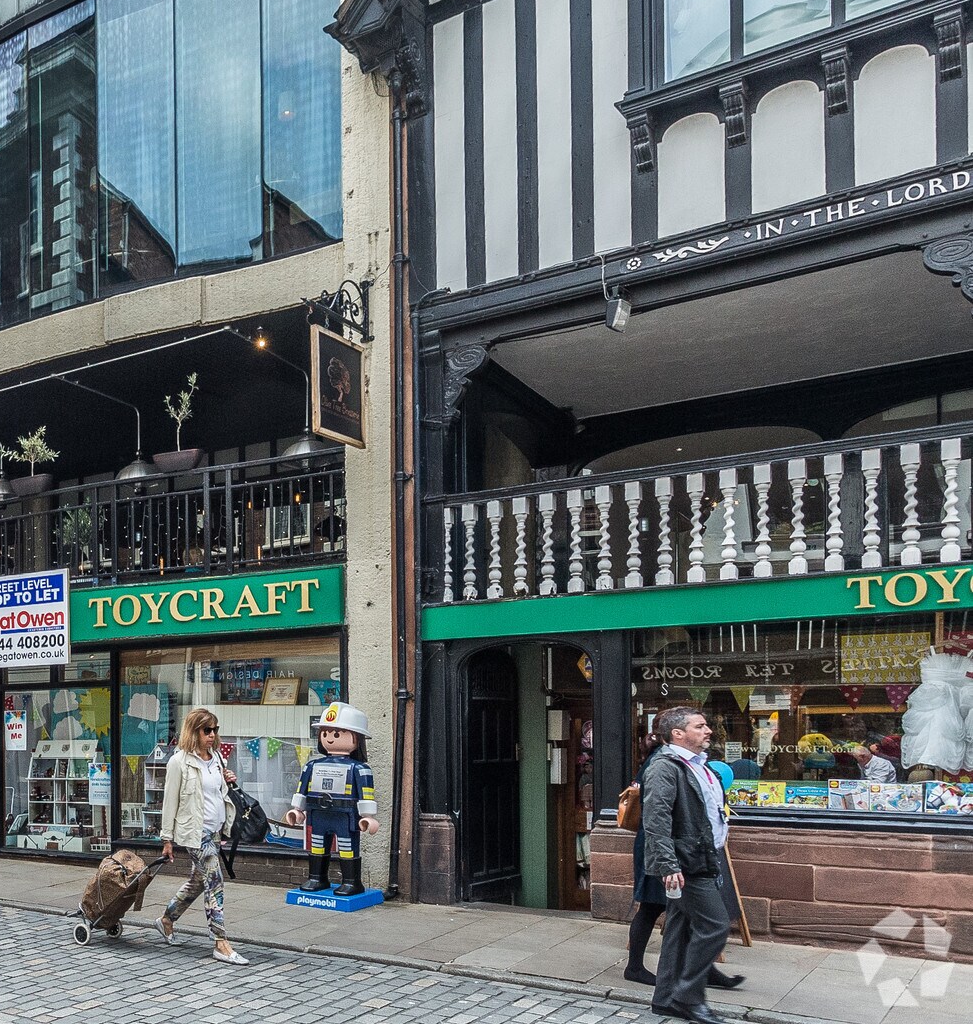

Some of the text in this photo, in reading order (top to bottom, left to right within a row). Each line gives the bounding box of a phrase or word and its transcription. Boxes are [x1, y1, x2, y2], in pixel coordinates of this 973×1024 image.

[755, 218, 785, 241] IN
[803, 197, 866, 228] THE
[21, 578, 52, 591] LEVEL
[847, 567, 973, 609] TOY
[13, 591, 32, 604] TO
[35, 588, 60, 602] LET
[88, 578, 320, 628] TOYCRAFT
[17, 633, 65, 650] 408200
[297, 895, 337, 908] playmobil
